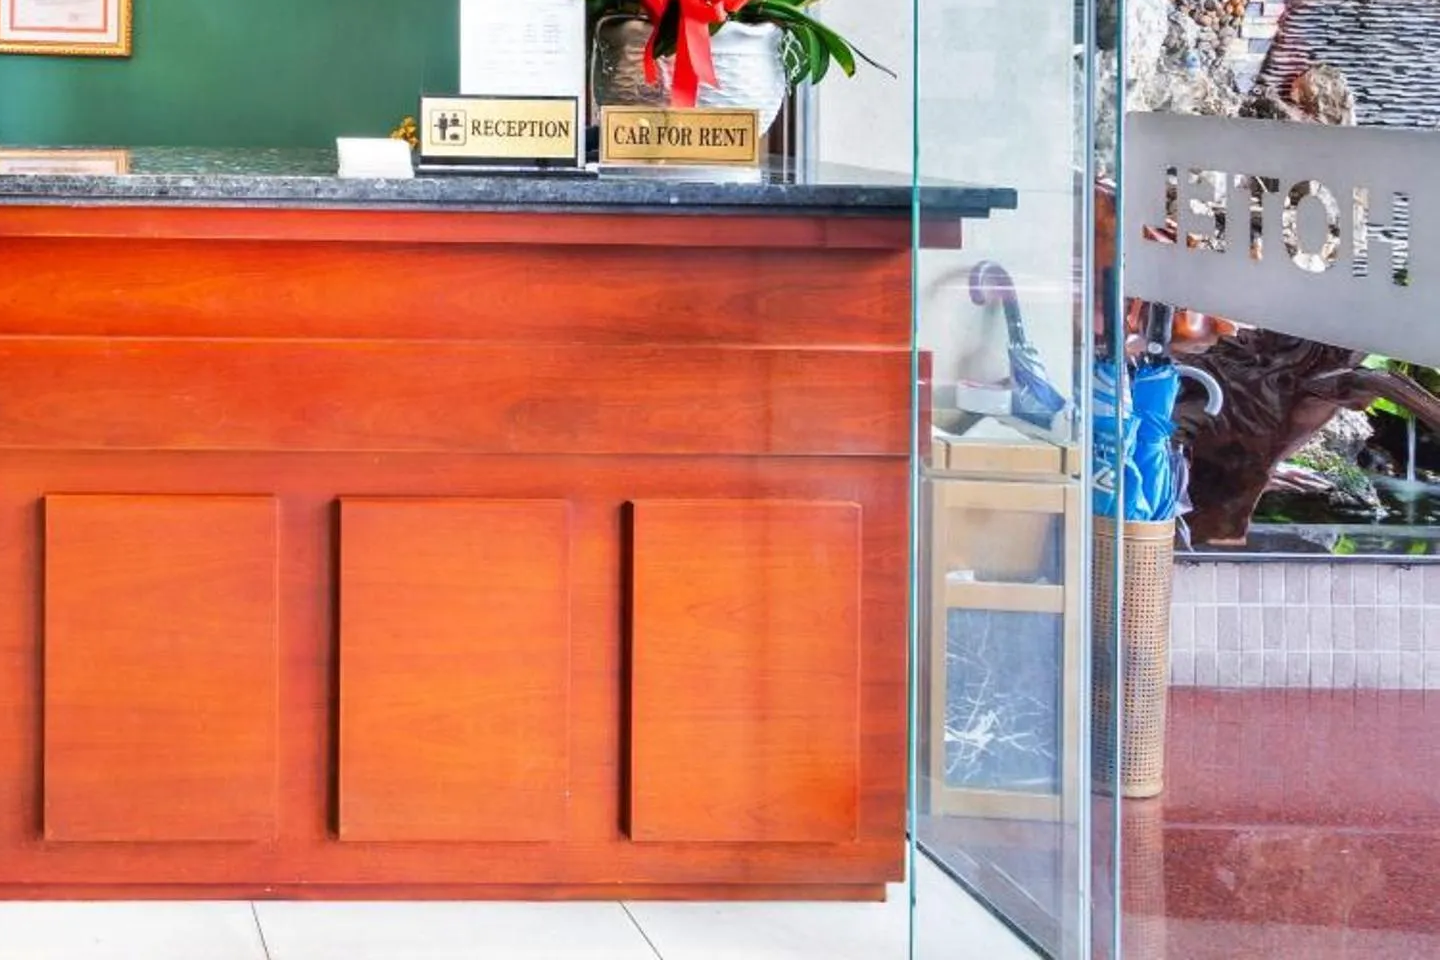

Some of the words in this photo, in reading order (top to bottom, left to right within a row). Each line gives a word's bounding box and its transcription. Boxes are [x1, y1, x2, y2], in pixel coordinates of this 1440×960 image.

[470, 118, 570, 138] RECEPTION
[613, 125, 650, 146] CAR
[656, 125, 693, 146] FOR
[698, 127, 748, 148] RENT
